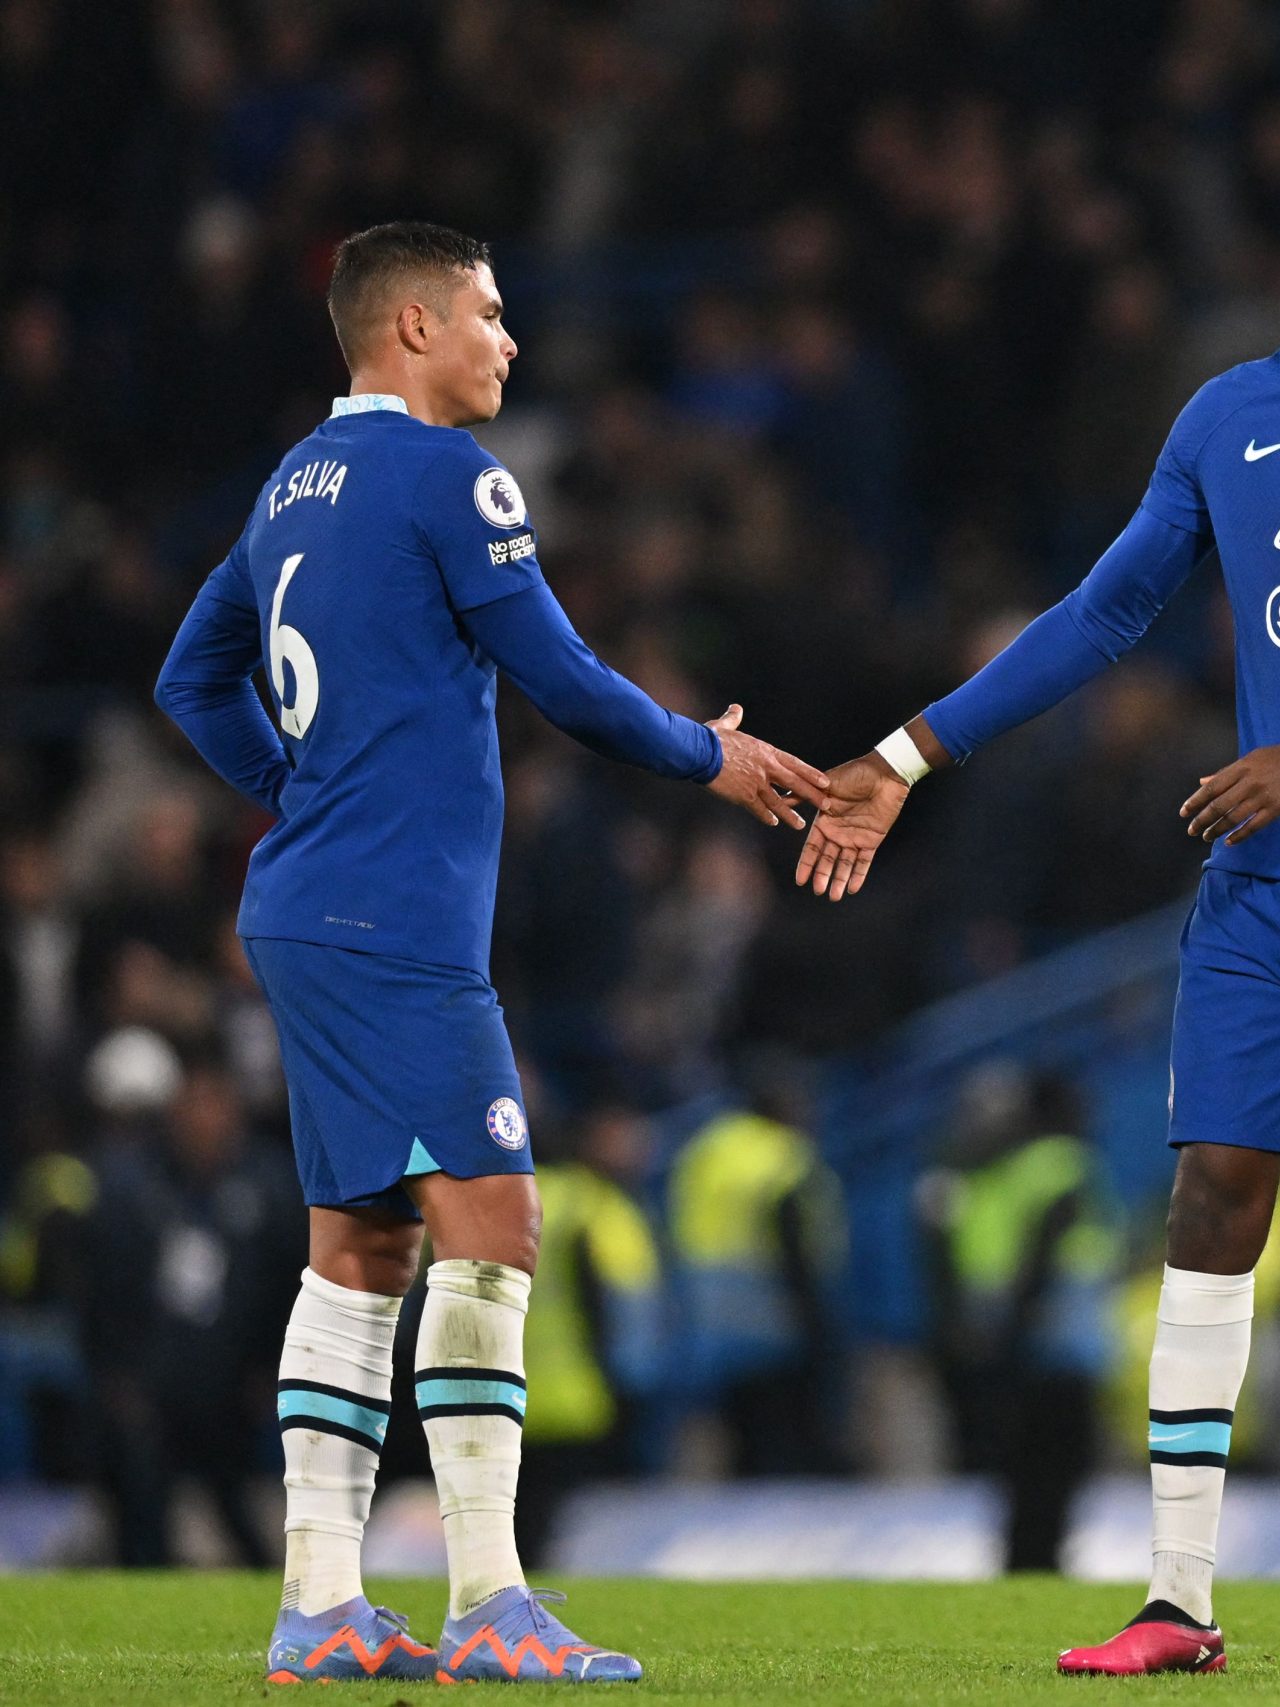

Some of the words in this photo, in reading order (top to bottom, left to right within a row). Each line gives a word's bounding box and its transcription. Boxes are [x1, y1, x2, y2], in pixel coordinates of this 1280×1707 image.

[488, 541, 508, 555] No
[508, 533, 532, 551] room
[490, 552, 509, 566] for
[510, 542, 536, 561] racism
[269, 552, 319, 740] 6
